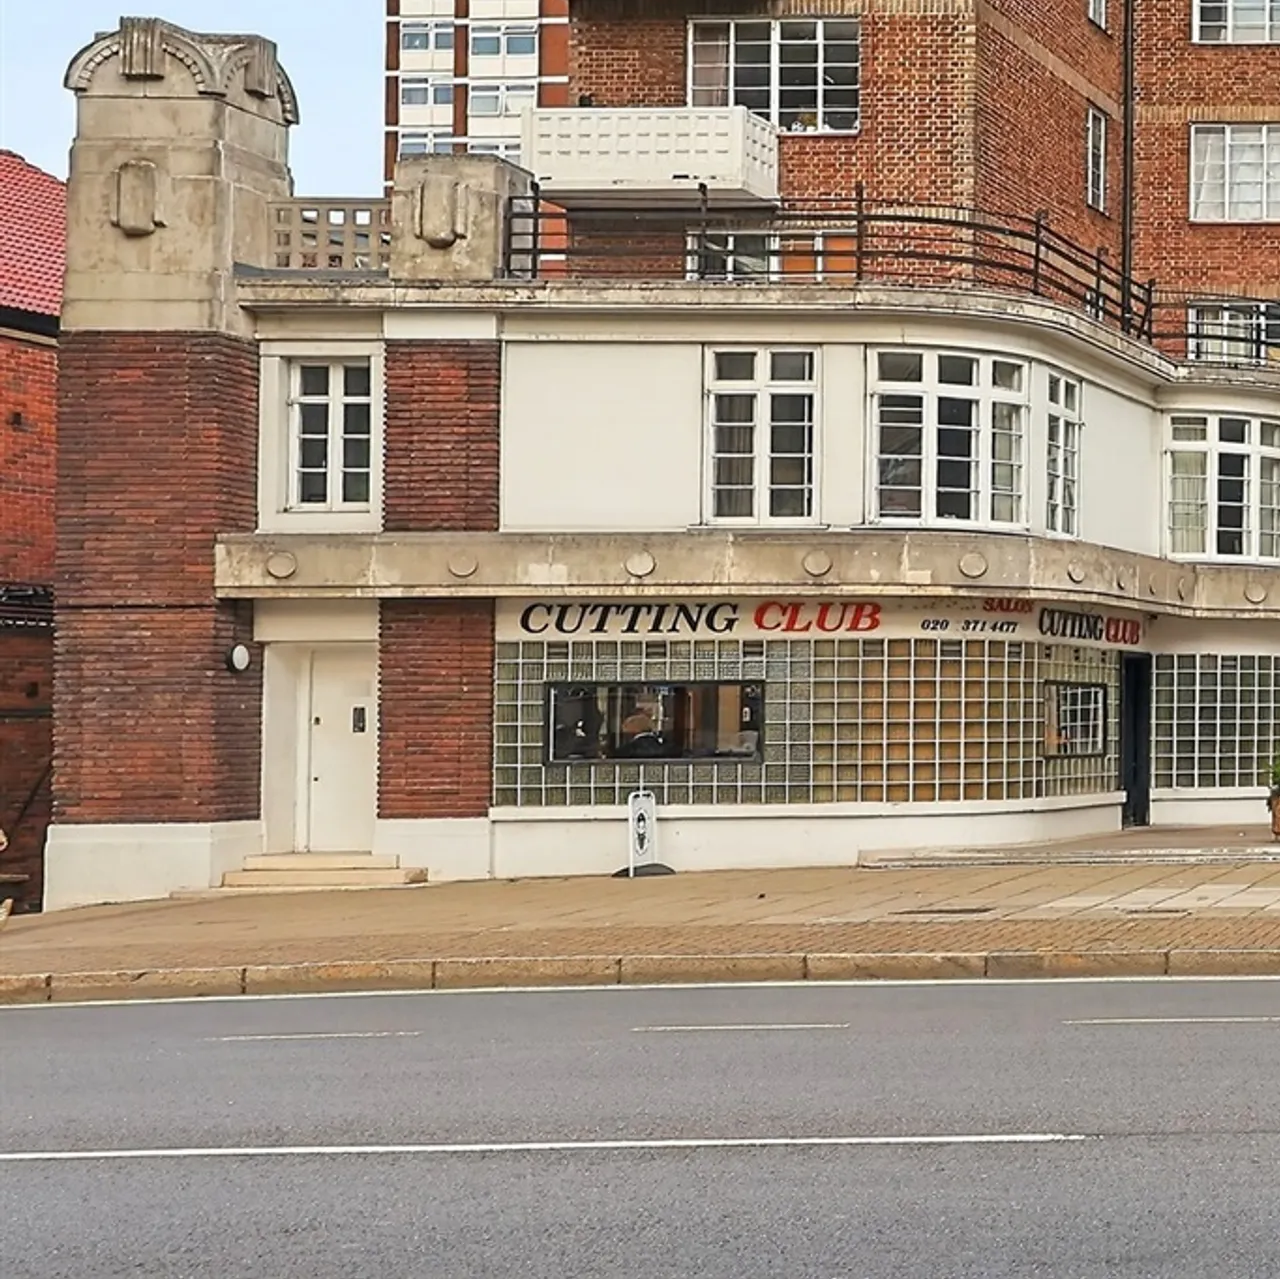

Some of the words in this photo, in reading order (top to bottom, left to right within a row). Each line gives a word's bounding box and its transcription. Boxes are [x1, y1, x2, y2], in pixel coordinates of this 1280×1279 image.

[519, 601, 740, 634] CUTTING
[753, 600, 883, 633] CLUB
[921, 618, 950, 631] 020
[1038, 607, 1104, 641] CUTTING
[1104, 615, 1141, 645] CLUB
